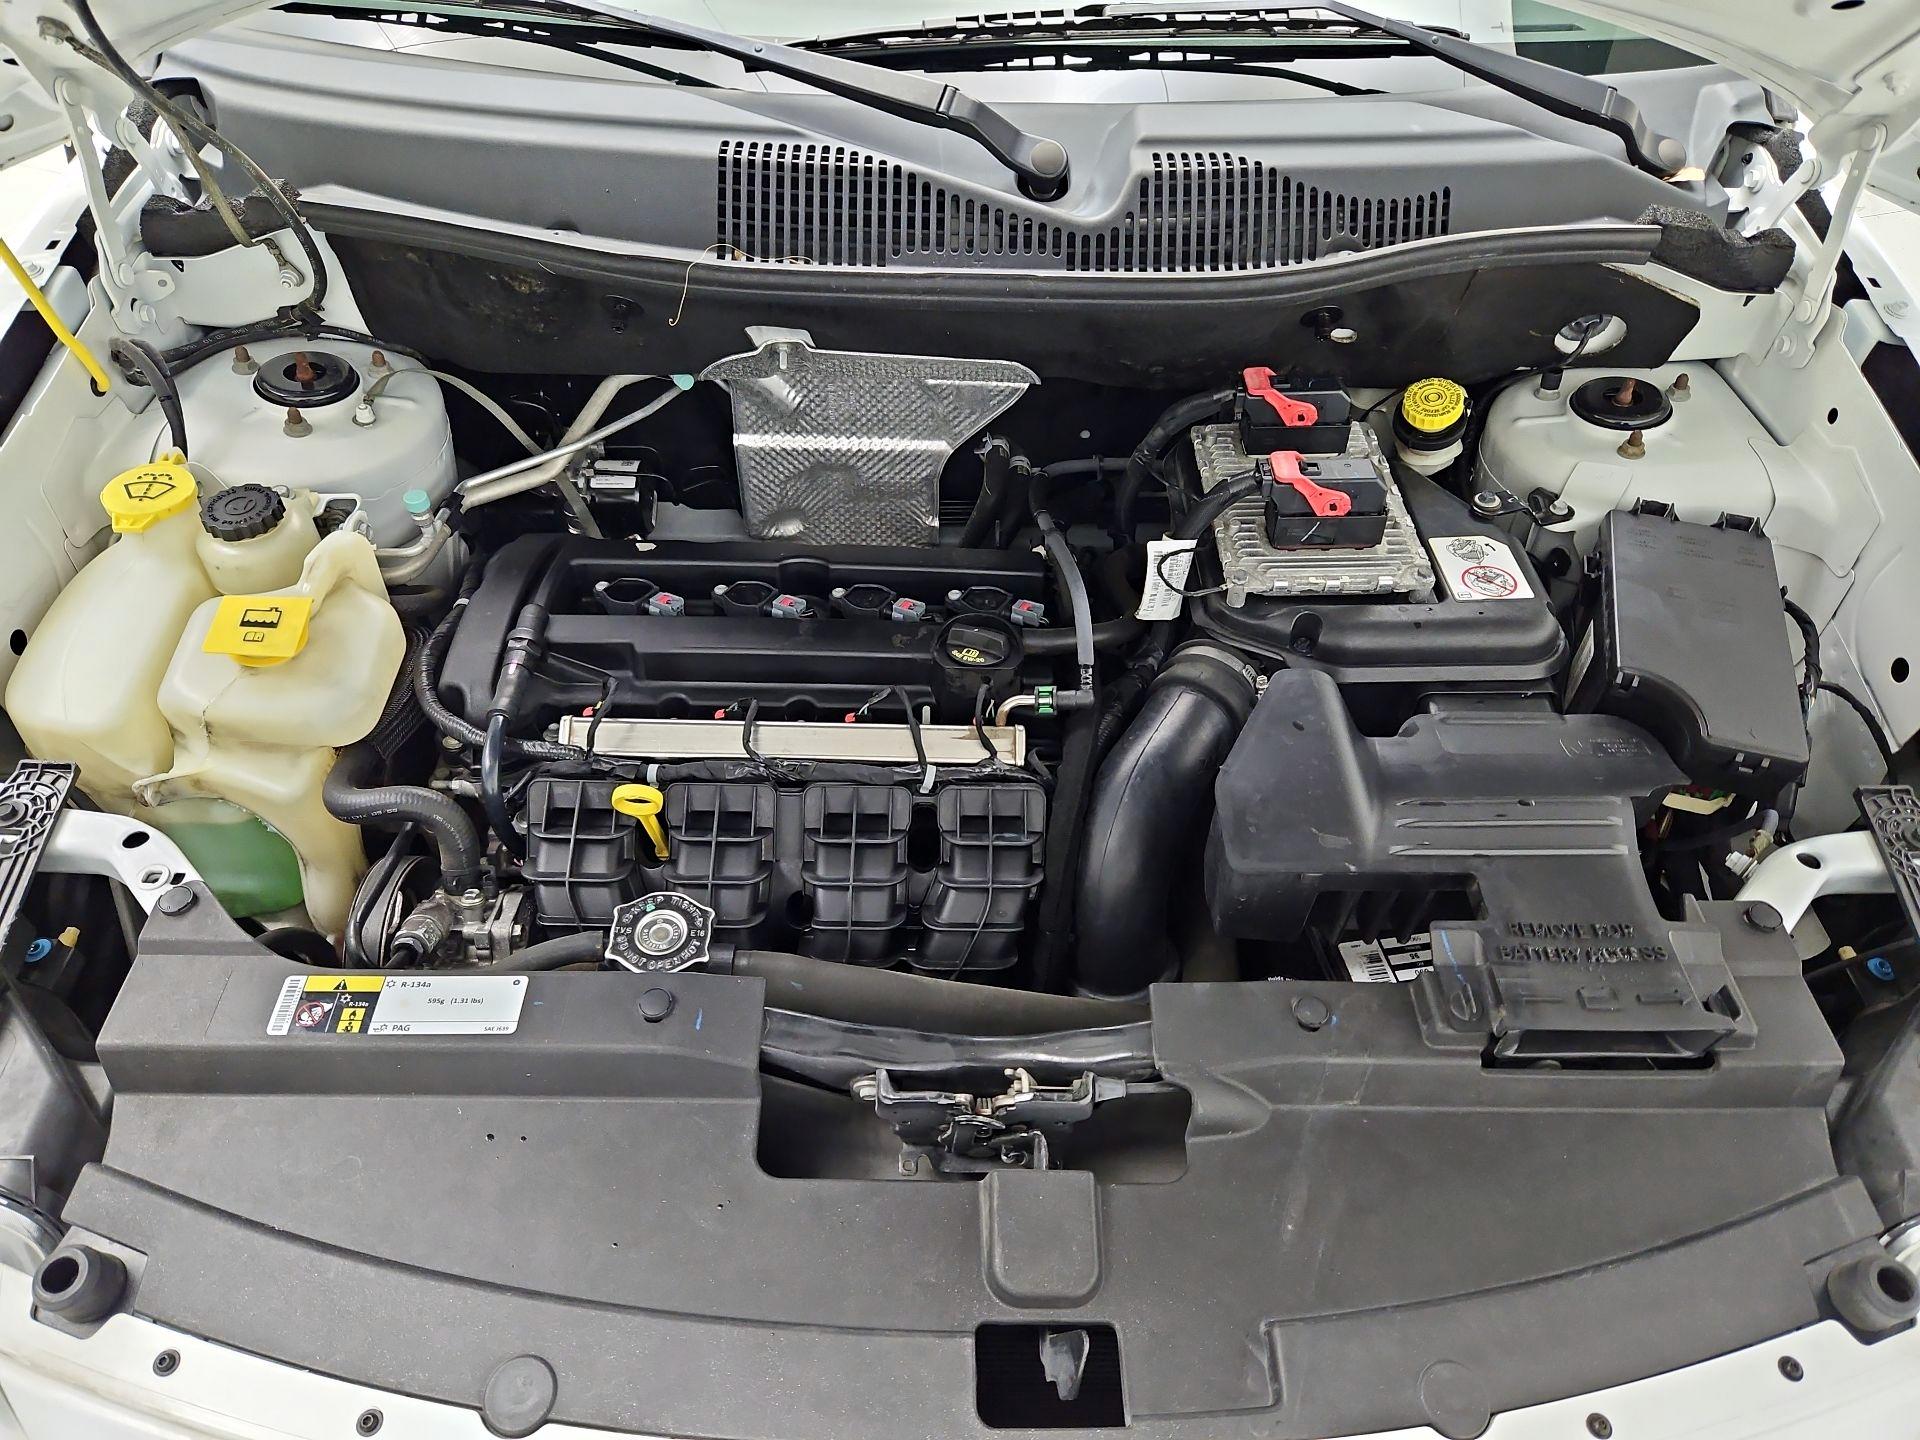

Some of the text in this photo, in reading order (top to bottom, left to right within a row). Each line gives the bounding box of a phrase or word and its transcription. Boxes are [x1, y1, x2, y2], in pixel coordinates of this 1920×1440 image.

[631, 896, 702, 918] KEEP TIGHT
[1507, 921, 1635, 938] REMOVE FOR
[623, 949, 647, 967] NOT
[647, 956, 682, 970] OPEN
[681, 938, 701, 960] HOT
[1498, 945, 1668, 963] BATTERY ACCESS
[427, 997, 484, 1005] 595g (1.31 lbs)
[391, 1024, 411, 1032] PAG
